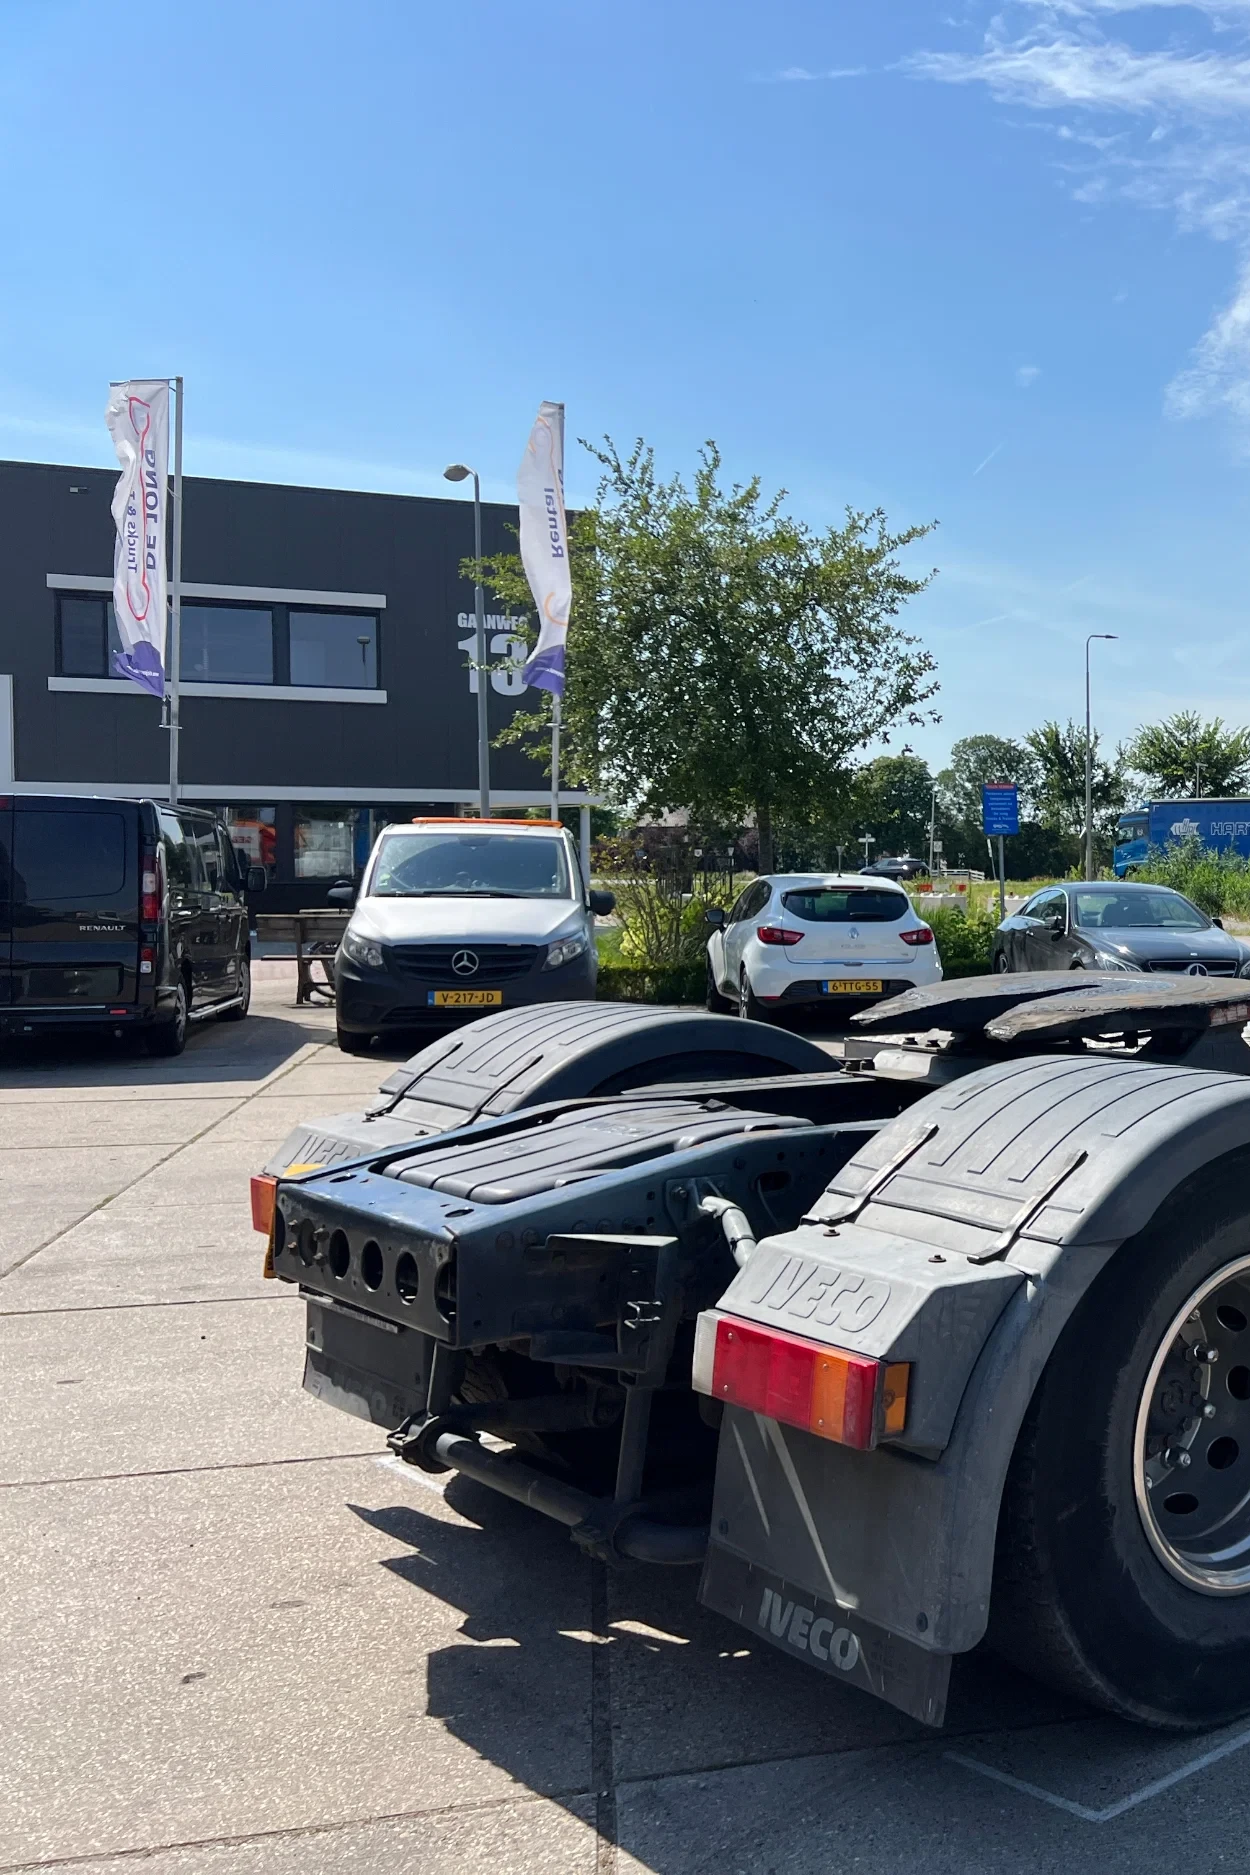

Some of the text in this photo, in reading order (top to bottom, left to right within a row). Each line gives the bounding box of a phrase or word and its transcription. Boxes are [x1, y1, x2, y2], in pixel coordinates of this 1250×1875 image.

[458, 633, 528, 696] 13
[441, 992, 494, 1003] V-217-JD
[832, 981, 879, 991] 6-TTG-55
[751, 1254, 892, 1333] IVECO
[758, 1587, 859, 1671] IVECO
